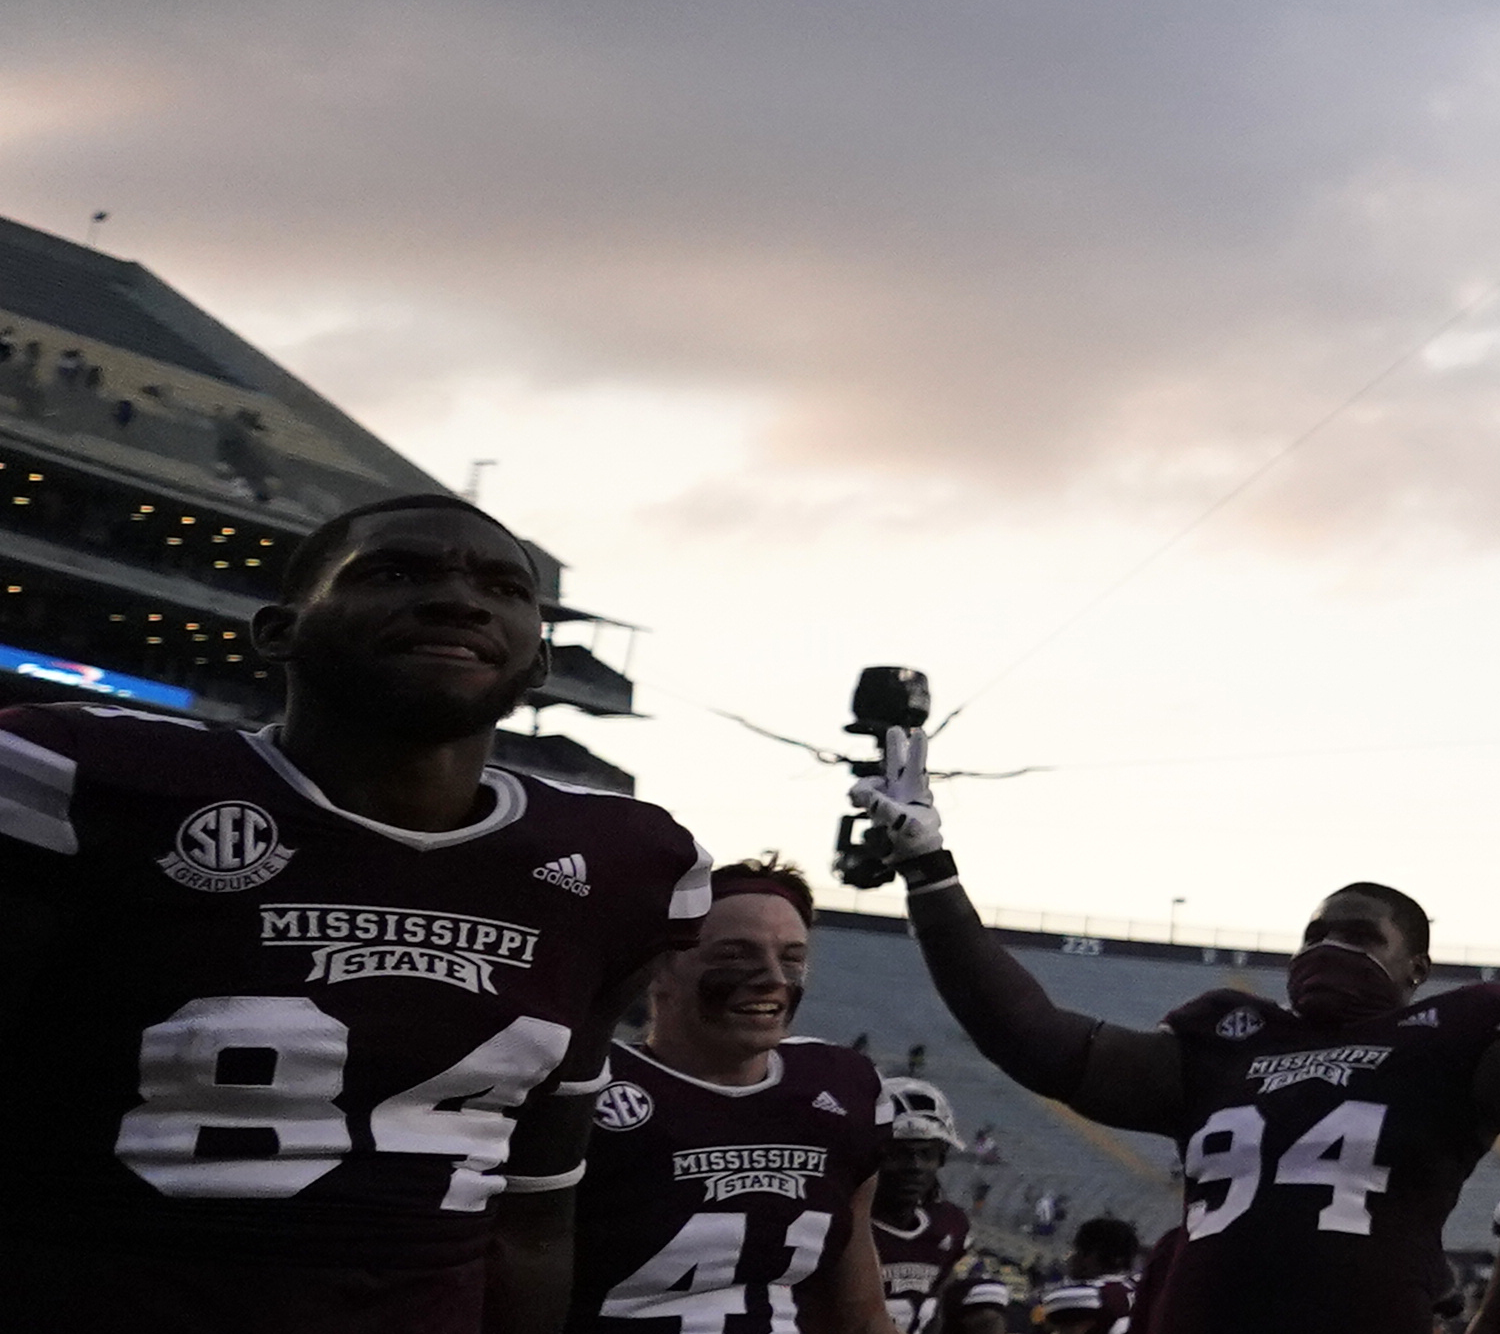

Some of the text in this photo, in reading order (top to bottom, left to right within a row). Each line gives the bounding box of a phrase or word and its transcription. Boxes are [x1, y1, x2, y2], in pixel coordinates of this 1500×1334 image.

[188, 806, 272, 867] SEC
[172, 859, 282, 892] GRADUATE
[533, 865, 590, 897] adidas
[260, 909, 539, 961] MISSISSIPPI
[344, 949, 467, 984] STATE
[114, 996, 572, 1212] 84
[674, 1148, 827, 1176] MISSISSIPPI
[1185, 1099, 1392, 1242] 94
[724, 1175, 789, 1193] STATE
